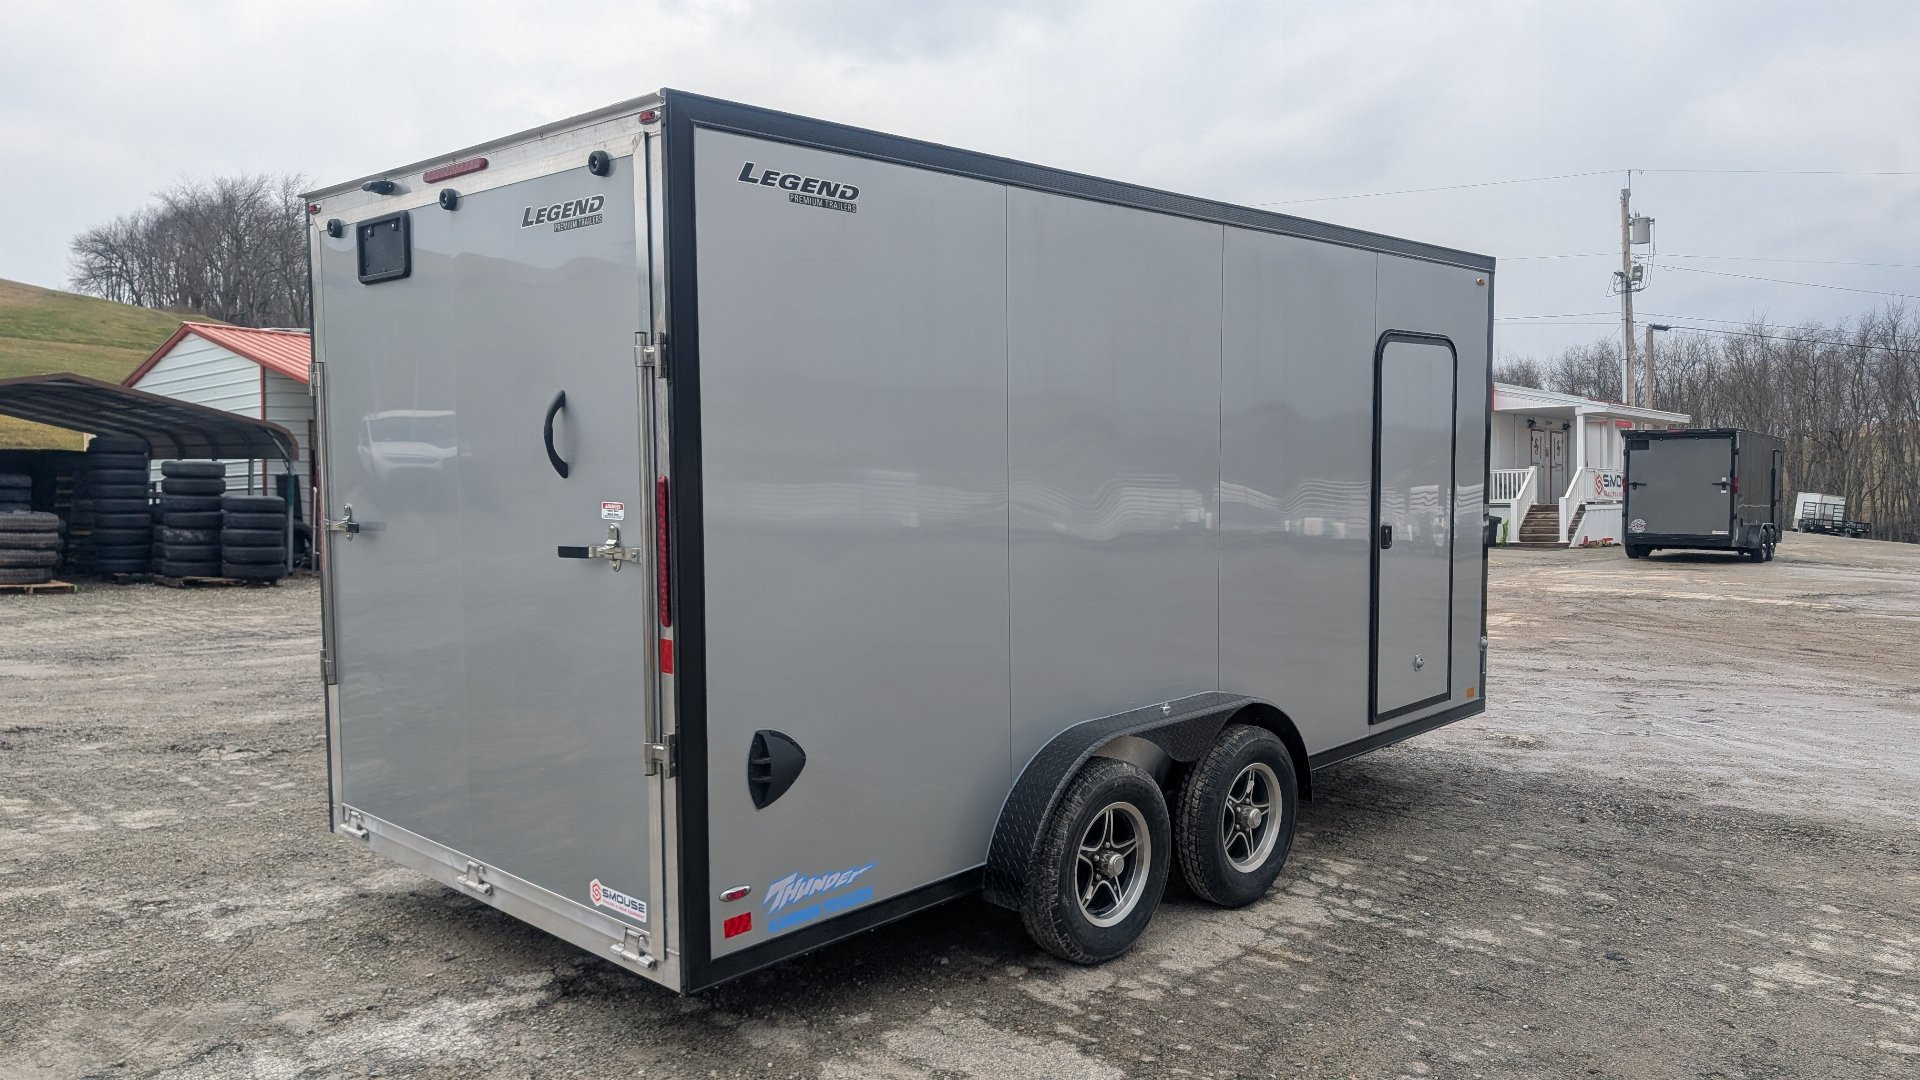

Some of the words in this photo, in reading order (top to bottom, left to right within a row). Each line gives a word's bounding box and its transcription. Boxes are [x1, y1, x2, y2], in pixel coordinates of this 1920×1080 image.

[738, 161, 860, 201] LEGEND
[521, 194, 605, 228] LEGEND
[789, 193, 823, 208] PREMIUM
[824, 199, 857, 213] TRAILERS
[554, 217, 579, 232] PREMIUM
[602, 888, 645, 913] SMOUSE
